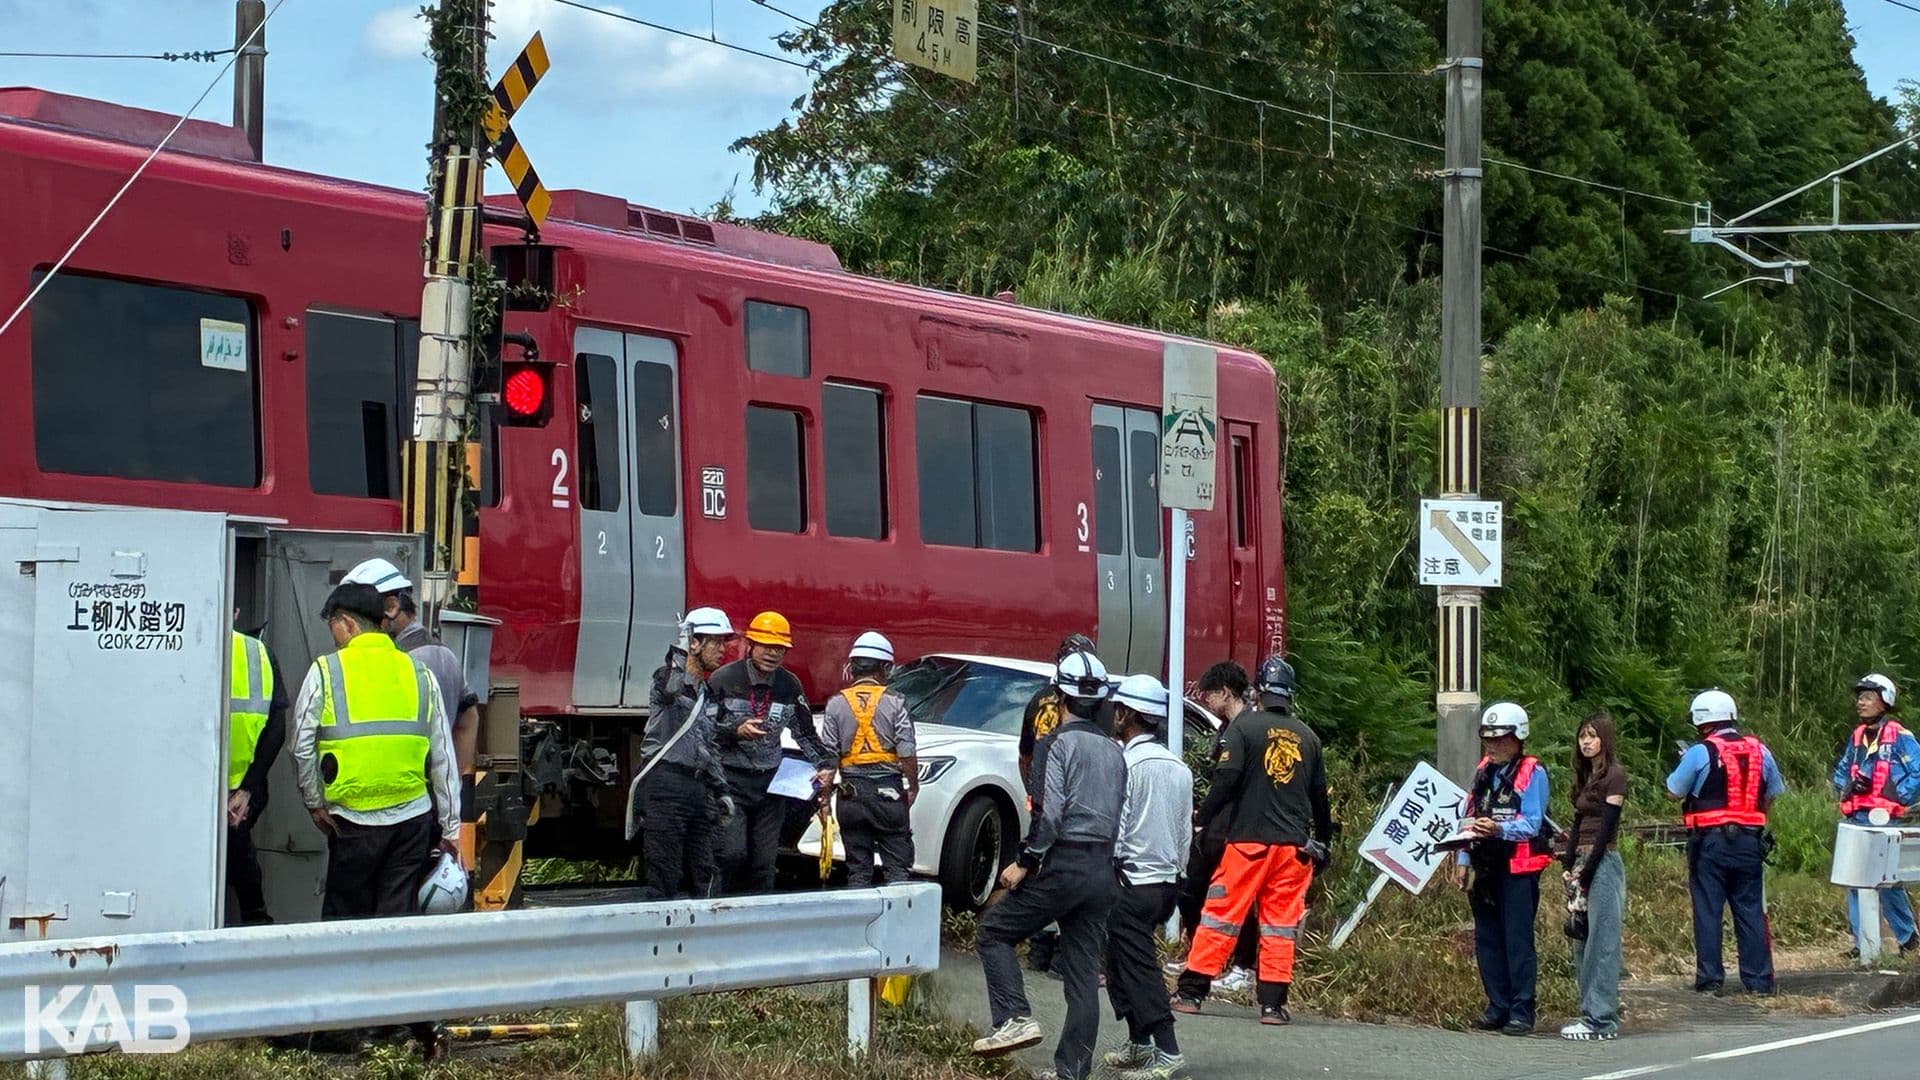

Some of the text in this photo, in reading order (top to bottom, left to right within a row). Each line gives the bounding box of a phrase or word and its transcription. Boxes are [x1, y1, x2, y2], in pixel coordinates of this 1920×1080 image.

[551, 448, 569, 496] 2
[703, 488, 726, 516] DC
[1077, 502, 1089, 542] 3
[598, 530, 607, 555] 2
[655, 535, 665, 559] 2
[1424, 557, 1460, 576] 注意
[1107, 570, 1115, 591] 3
[1146, 573, 1153, 594] 3
[67, 600, 185, 633] 上柳水踏切
[1383, 778, 1438, 846] 公民館
